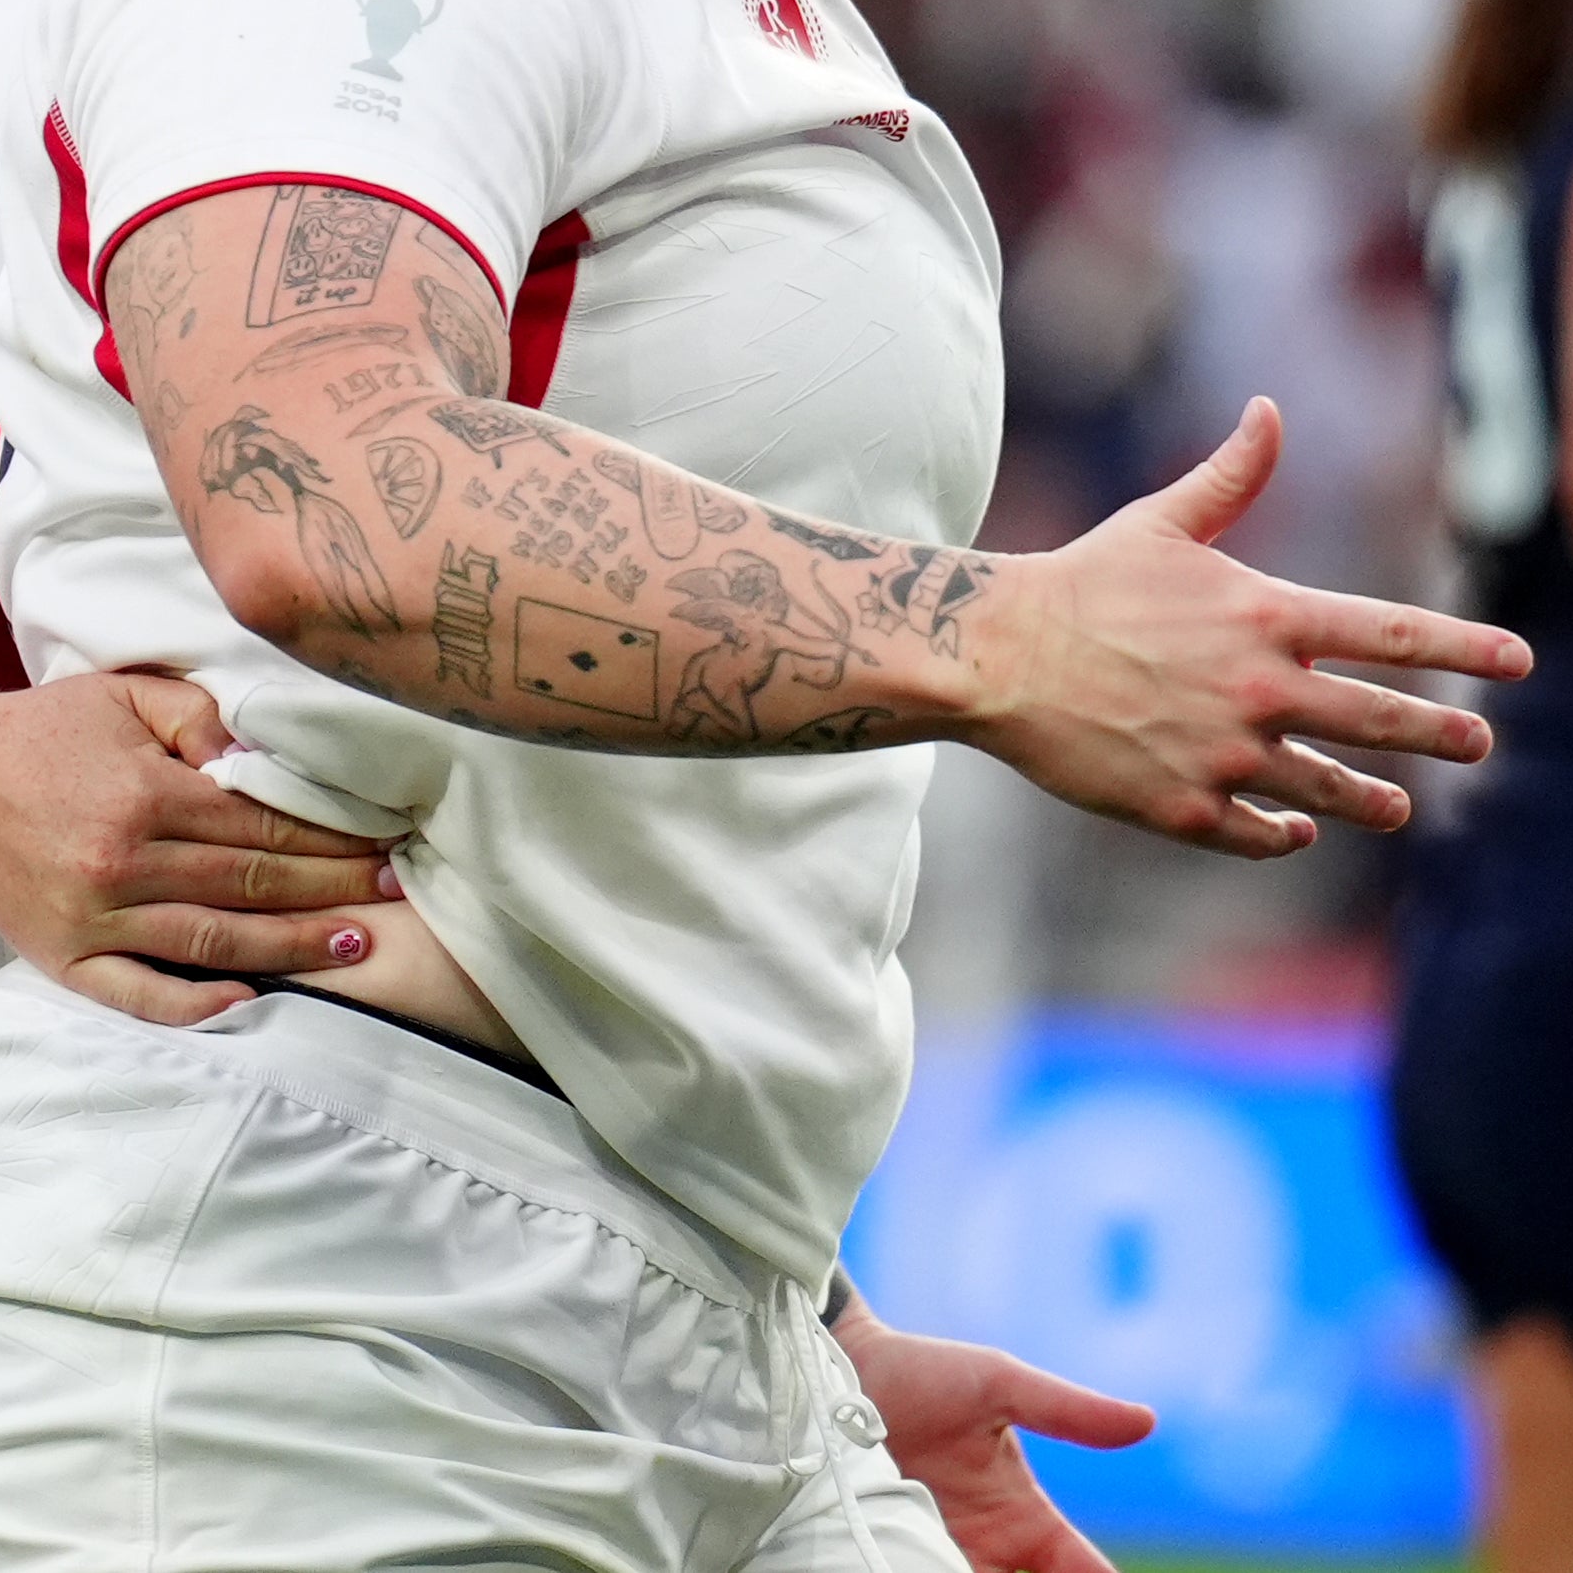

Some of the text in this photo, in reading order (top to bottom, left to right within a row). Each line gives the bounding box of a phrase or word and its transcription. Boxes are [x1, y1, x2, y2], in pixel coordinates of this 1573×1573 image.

[333, 94, 401, 124] 2014
[340, 80, 403, 109] 1994
[462, 476, 493, 509] IF
[494, 466, 551, 522] IT'S
[509, 466, 591, 558] MEANT
[535, 487, 610, 568] TO BE
[603, 553, 648, 604] BE
[431, 538, 500, 701] 2005
